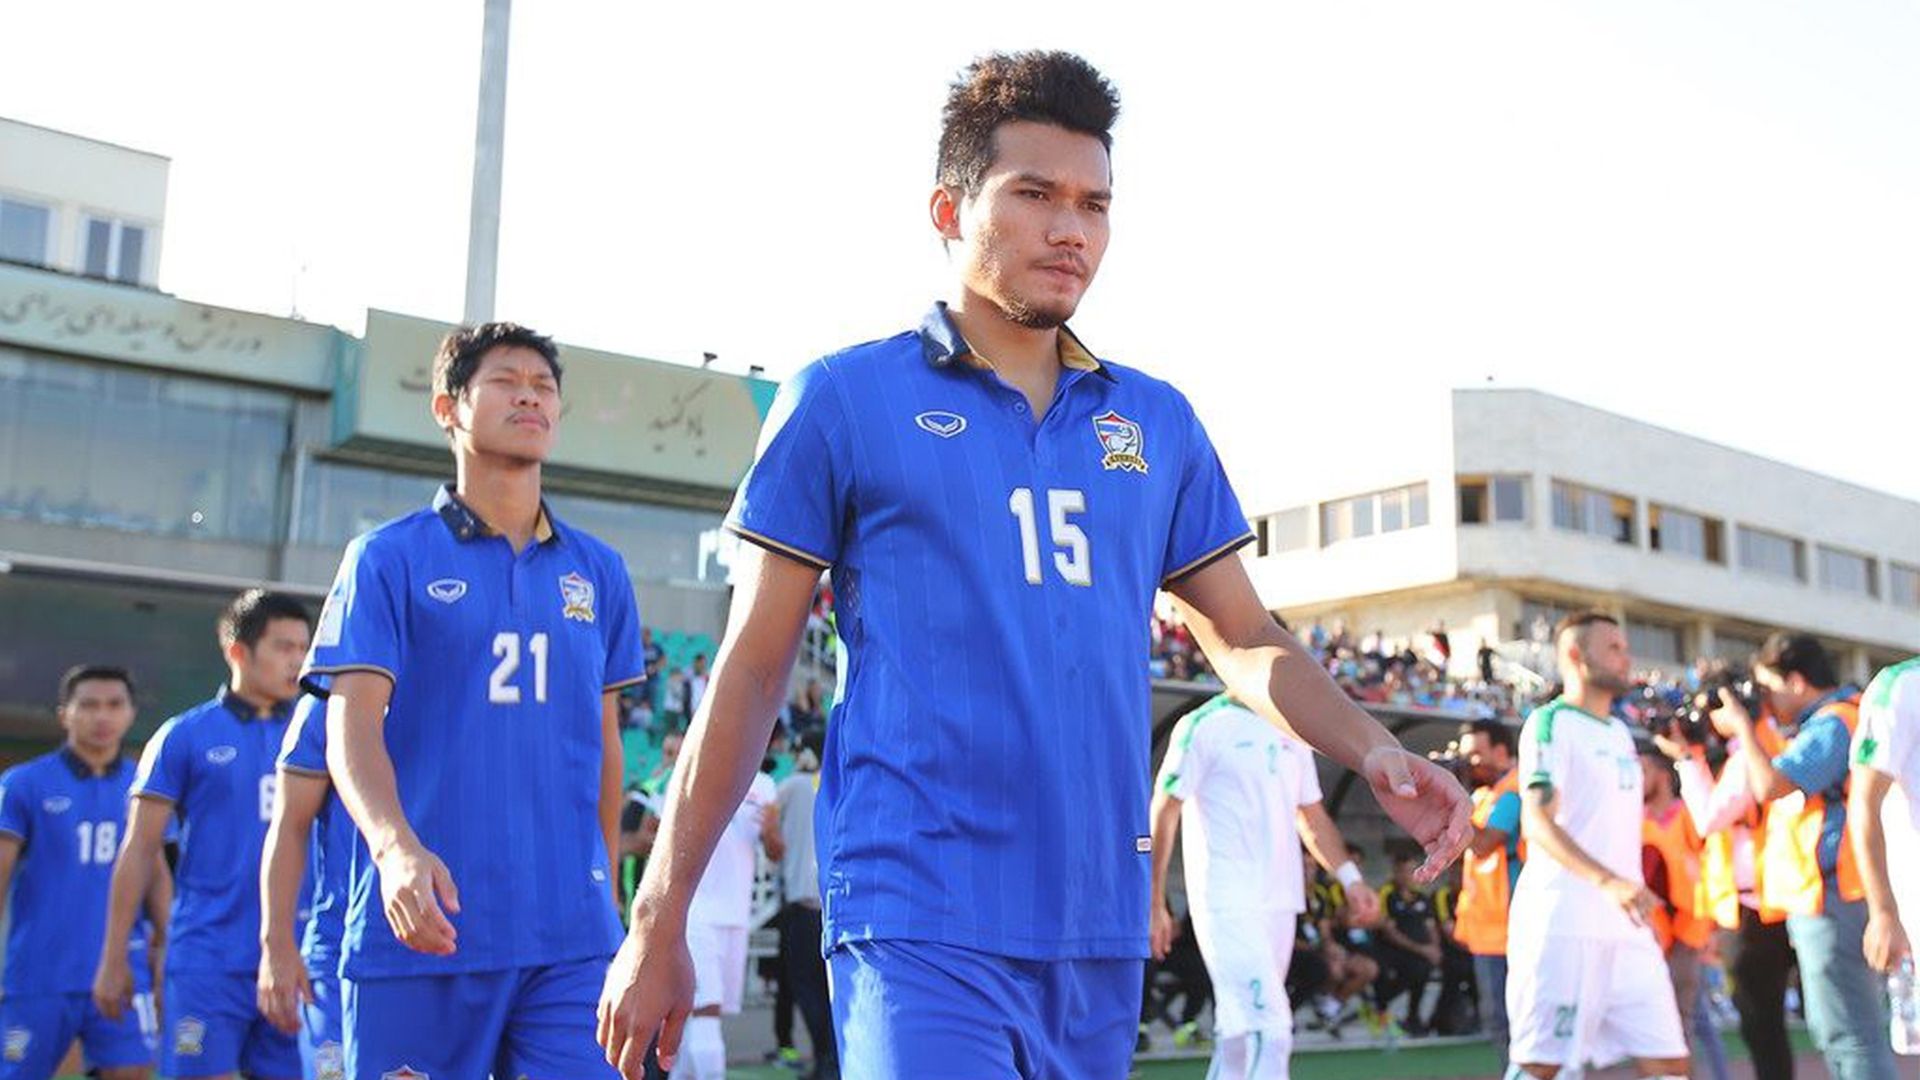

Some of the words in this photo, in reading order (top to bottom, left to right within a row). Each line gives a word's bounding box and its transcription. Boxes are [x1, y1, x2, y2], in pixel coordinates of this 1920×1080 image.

[1009, 487, 1092, 587] 15
[489, 632, 549, 704] 21
[77, 821, 118, 864] 18
[1249, 978, 1265, 1010] 2
